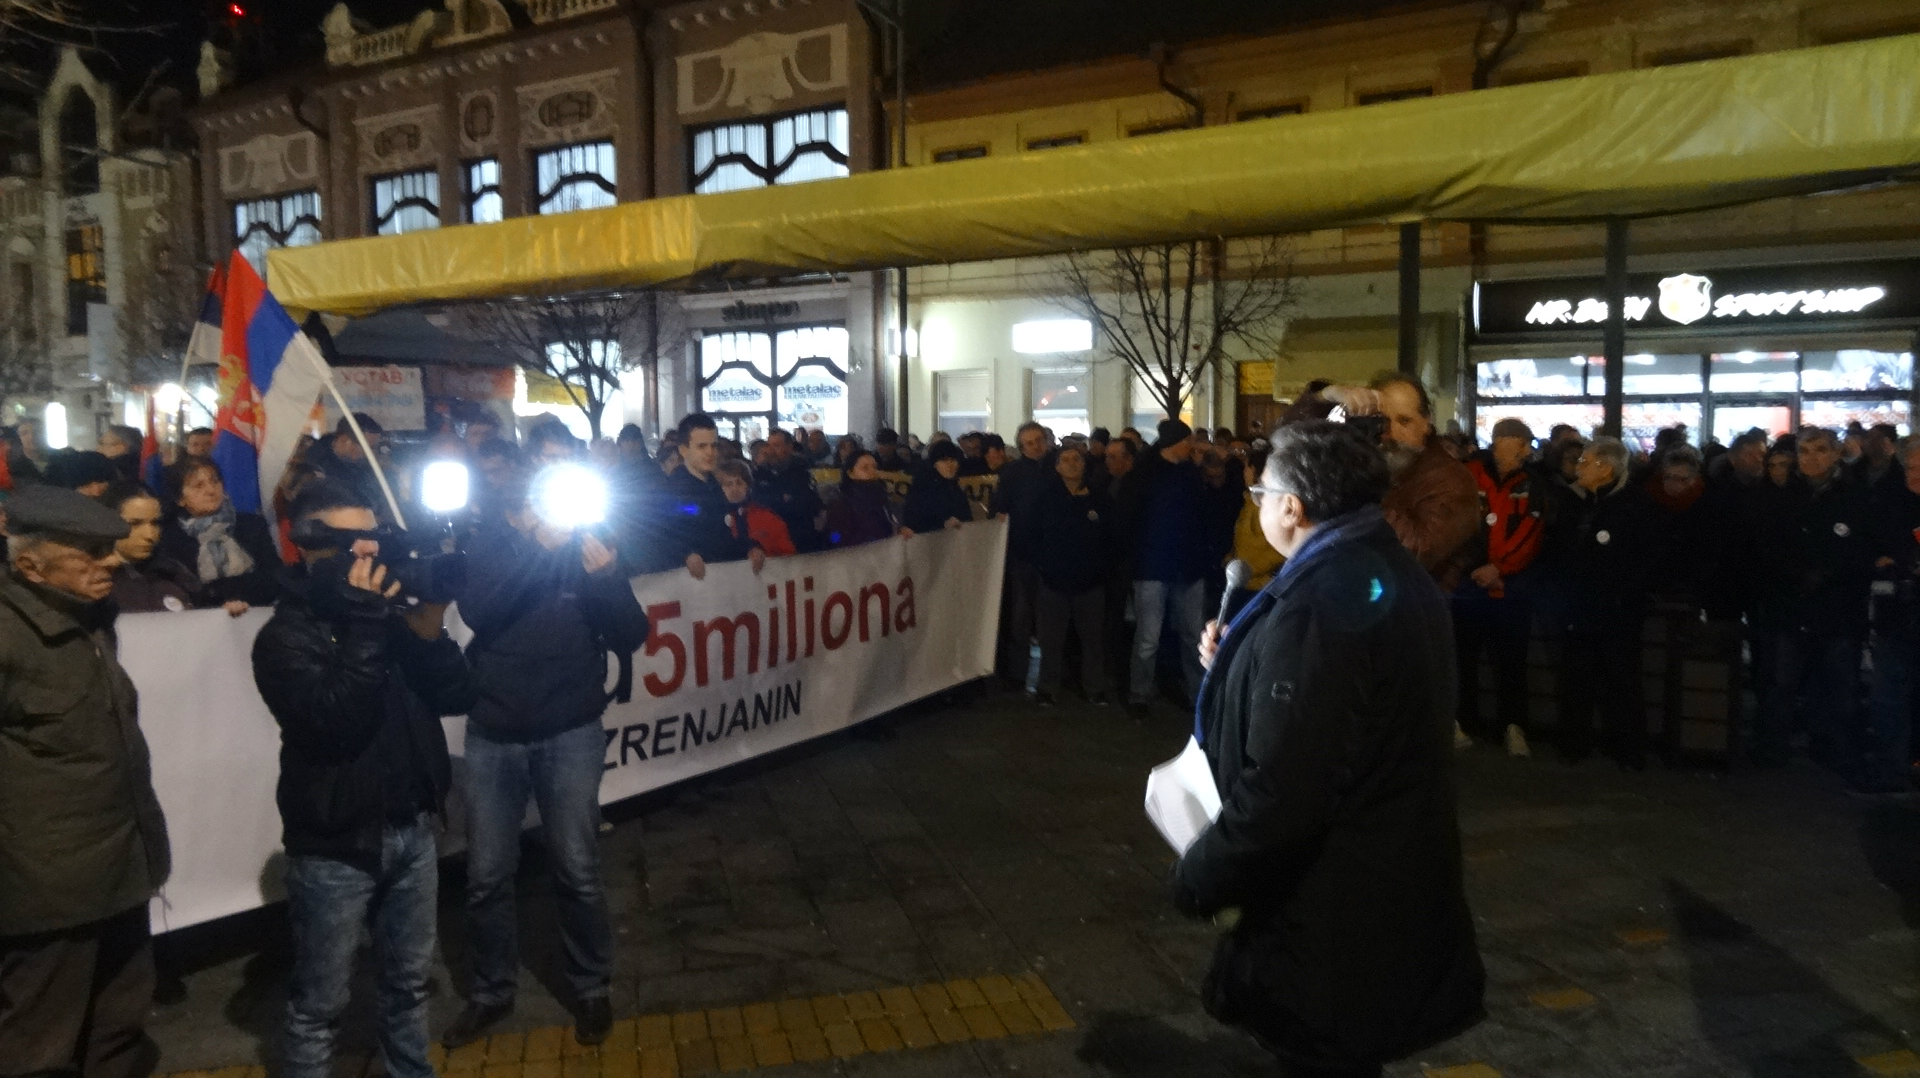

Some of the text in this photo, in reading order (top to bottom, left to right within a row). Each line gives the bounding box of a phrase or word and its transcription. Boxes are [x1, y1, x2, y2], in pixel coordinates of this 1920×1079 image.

[708, 386, 763, 397] metalac
[784, 382, 842, 394] metalac
[603, 679, 803, 771] ZRENJANIN
